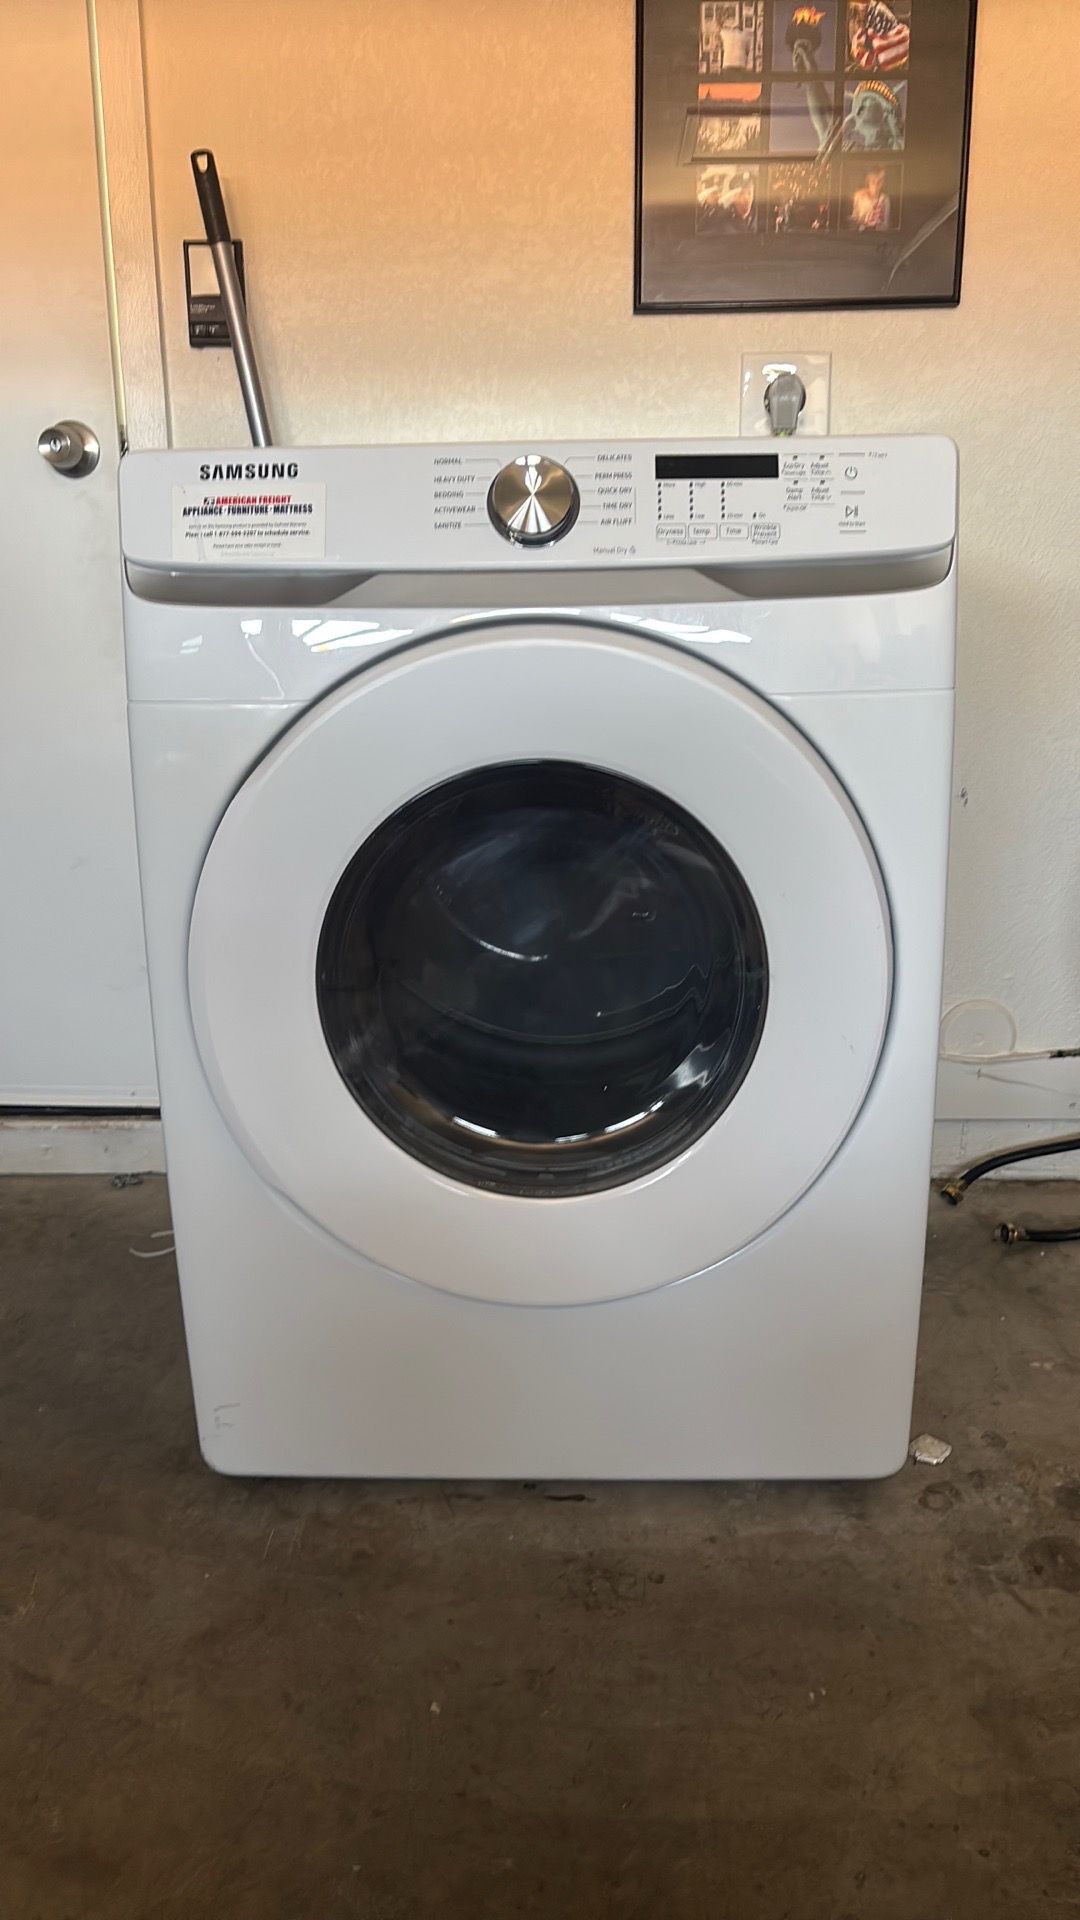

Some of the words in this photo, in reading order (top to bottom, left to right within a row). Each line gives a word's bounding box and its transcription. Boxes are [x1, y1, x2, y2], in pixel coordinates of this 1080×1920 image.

[433, 457, 462, 465] NORMAL
[597, 454, 633, 462] DELICATES
[200, 463, 299, 480] SAMSUNG
[594, 472, 613, 480] PERM
[613, 471, 633, 479] PRESS
[433, 475, 456, 483] HEAVY
[433, 491, 464, 499] BEDDING
[597, 487, 617, 495] QUICK
[216, 496, 258, 504] AMERICAN
[259, 495, 293, 503] FREIGHT
[183, 505, 223, 517] APPLIANCE
[226, 504, 269, 515] FURNITURE
[273, 503, 314, 514] MATTRESS
[602, 502, 618, 510] TIME
[619, 502, 633, 510] DRY
[433, 506, 476, 515] ACTIVEWEAR
[433, 522, 462, 530] SANITIZE
[600, 518, 613, 526] AIR
[612, 518, 633, 526] FLUFF
[658, 527, 684, 536] Dryness
[725, 527, 742, 535] Time
[617, 547, 628, 555] Dry
